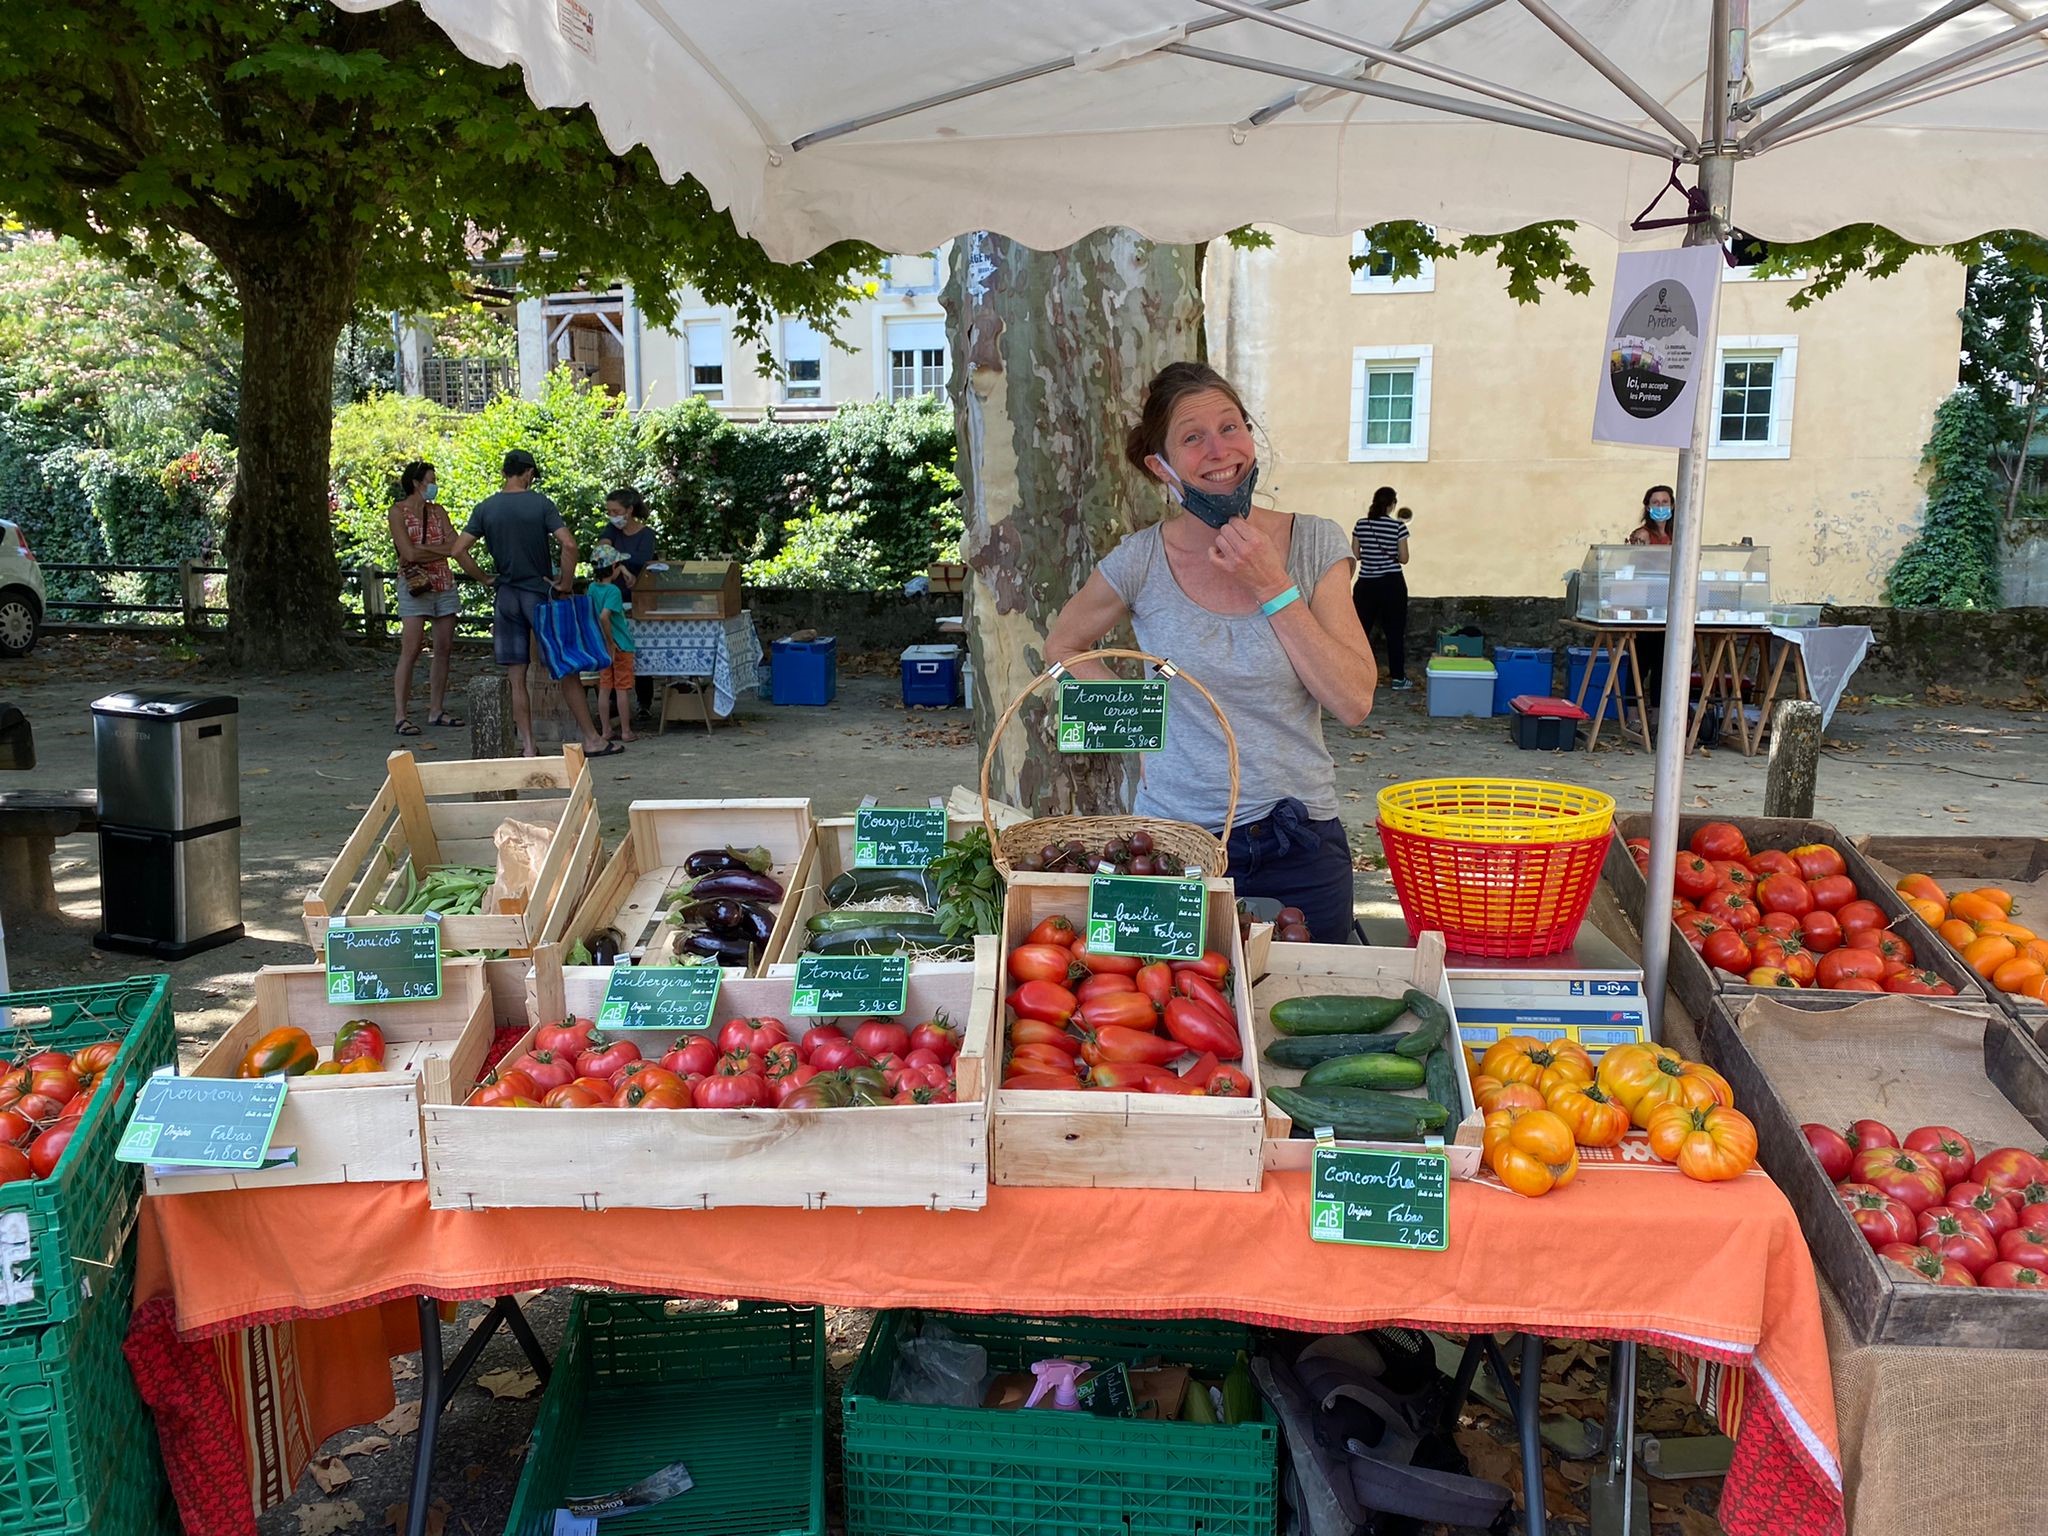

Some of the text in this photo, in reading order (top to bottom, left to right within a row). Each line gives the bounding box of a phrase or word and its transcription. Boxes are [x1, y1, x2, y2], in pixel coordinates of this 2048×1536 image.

[1648, 315, 1677, 330] Pyrène
[1626, 376, 1640, 390] Ici,
[1648, 382, 1669, 391] accepte
[1630, 392, 1662, 402] les Pyrènes
[1074, 686, 1135, 704] tomates
[1062, 728, 1081, 742] AB
[857, 847, 873, 859] AB
[1114, 902, 1161, 921] basilic
[343, 931, 401, 949] haricots
[1092, 928, 1111, 942] AB
[331, 979, 350, 993] AB
[614, 971, 691, 997] aubergines
[795, 994, 814, 1006] AB
[602, 1008, 622, 1020] AB
[150, 1085, 244, 1114] poivrons
[126, 1131, 151, 1147] AB
[164, 1125, 192, 1141] Origine
[1316, 1210, 1338, 1227] AB
[1347, 1203, 1373, 1221] Origine
